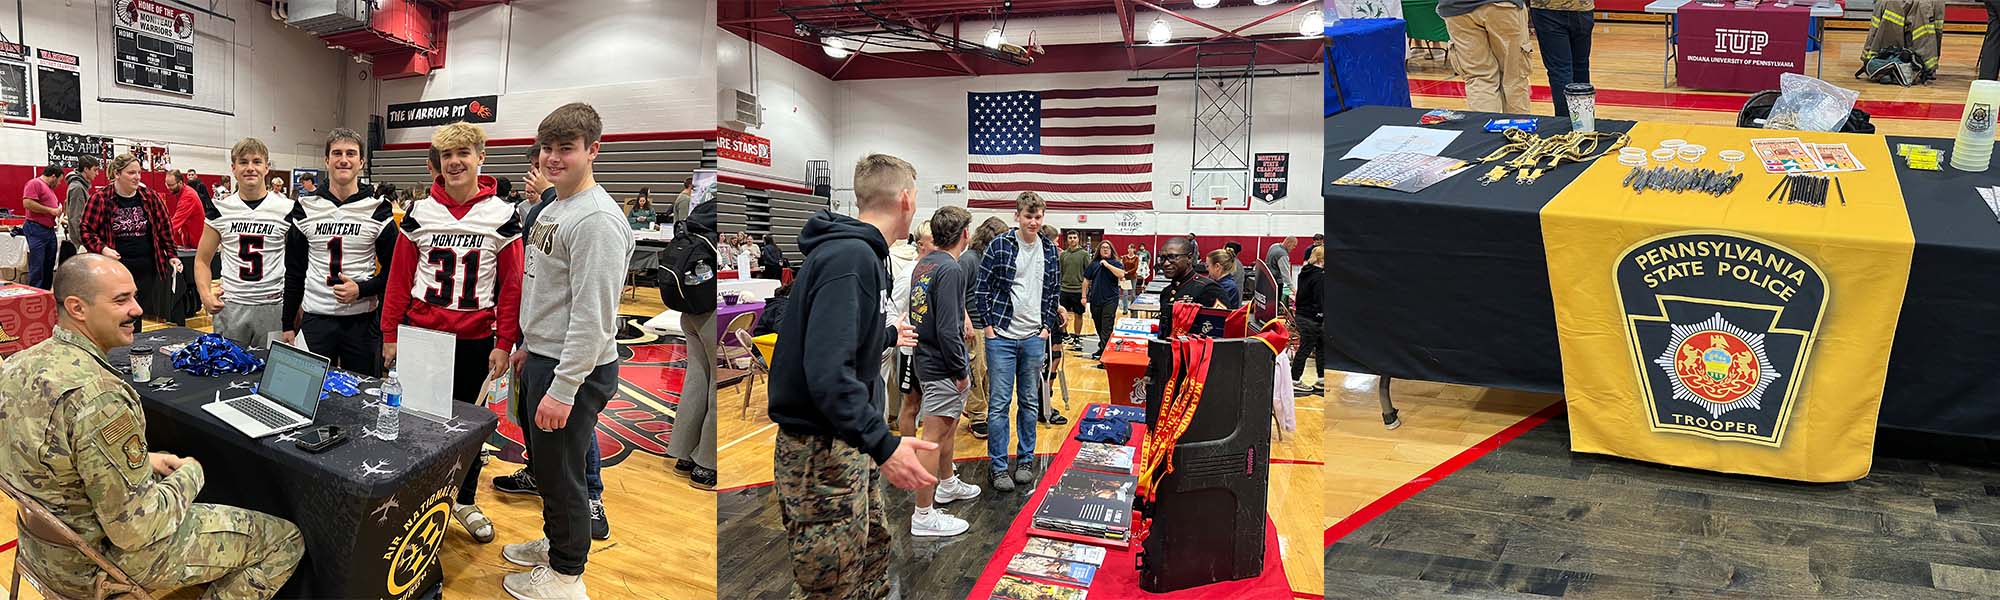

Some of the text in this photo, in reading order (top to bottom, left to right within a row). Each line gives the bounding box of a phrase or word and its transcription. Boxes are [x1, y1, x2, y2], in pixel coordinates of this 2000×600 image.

[138, 0, 174, 18] HOME OF THE
[140, 13, 173, 28] MONITEAU
[140, 22, 173, 37] WARRIORS
[118, 29, 134, 39] HOME
[1714, 28, 1769, 55] IUP
[175, 43, 193, 53] VISITOR
[1687, 55, 1711, 63] INDIANA
[1710, 57, 1743, 65] UNIVERSITY
[1752, 59, 1794, 68] PENNSYLVANIA
[390, 104, 468, 122] THE WARRIOR PIT
[78, 142, 101, 154] ARM
[732, 140, 758, 156] STARS
[229, 222, 275, 235] MONITEAU
[314, 222, 362, 236] MONITEAU
[430, 233, 486, 248] MONITEAU
[238, 233, 266, 282] 5
[326, 235, 344, 287] 1
[1634, 240, 1807, 287] PENNSYLVANIA
[424, 247, 481, 310] 31
[1643, 260, 1797, 303] STATE POLICE
[1173, 381, 1204, 440] MARINES
[1671, 413, 1759, 435] TROOPER
[383, 535, 404, 560] AIR
[403, 484, 452, 531] NATIONAL
